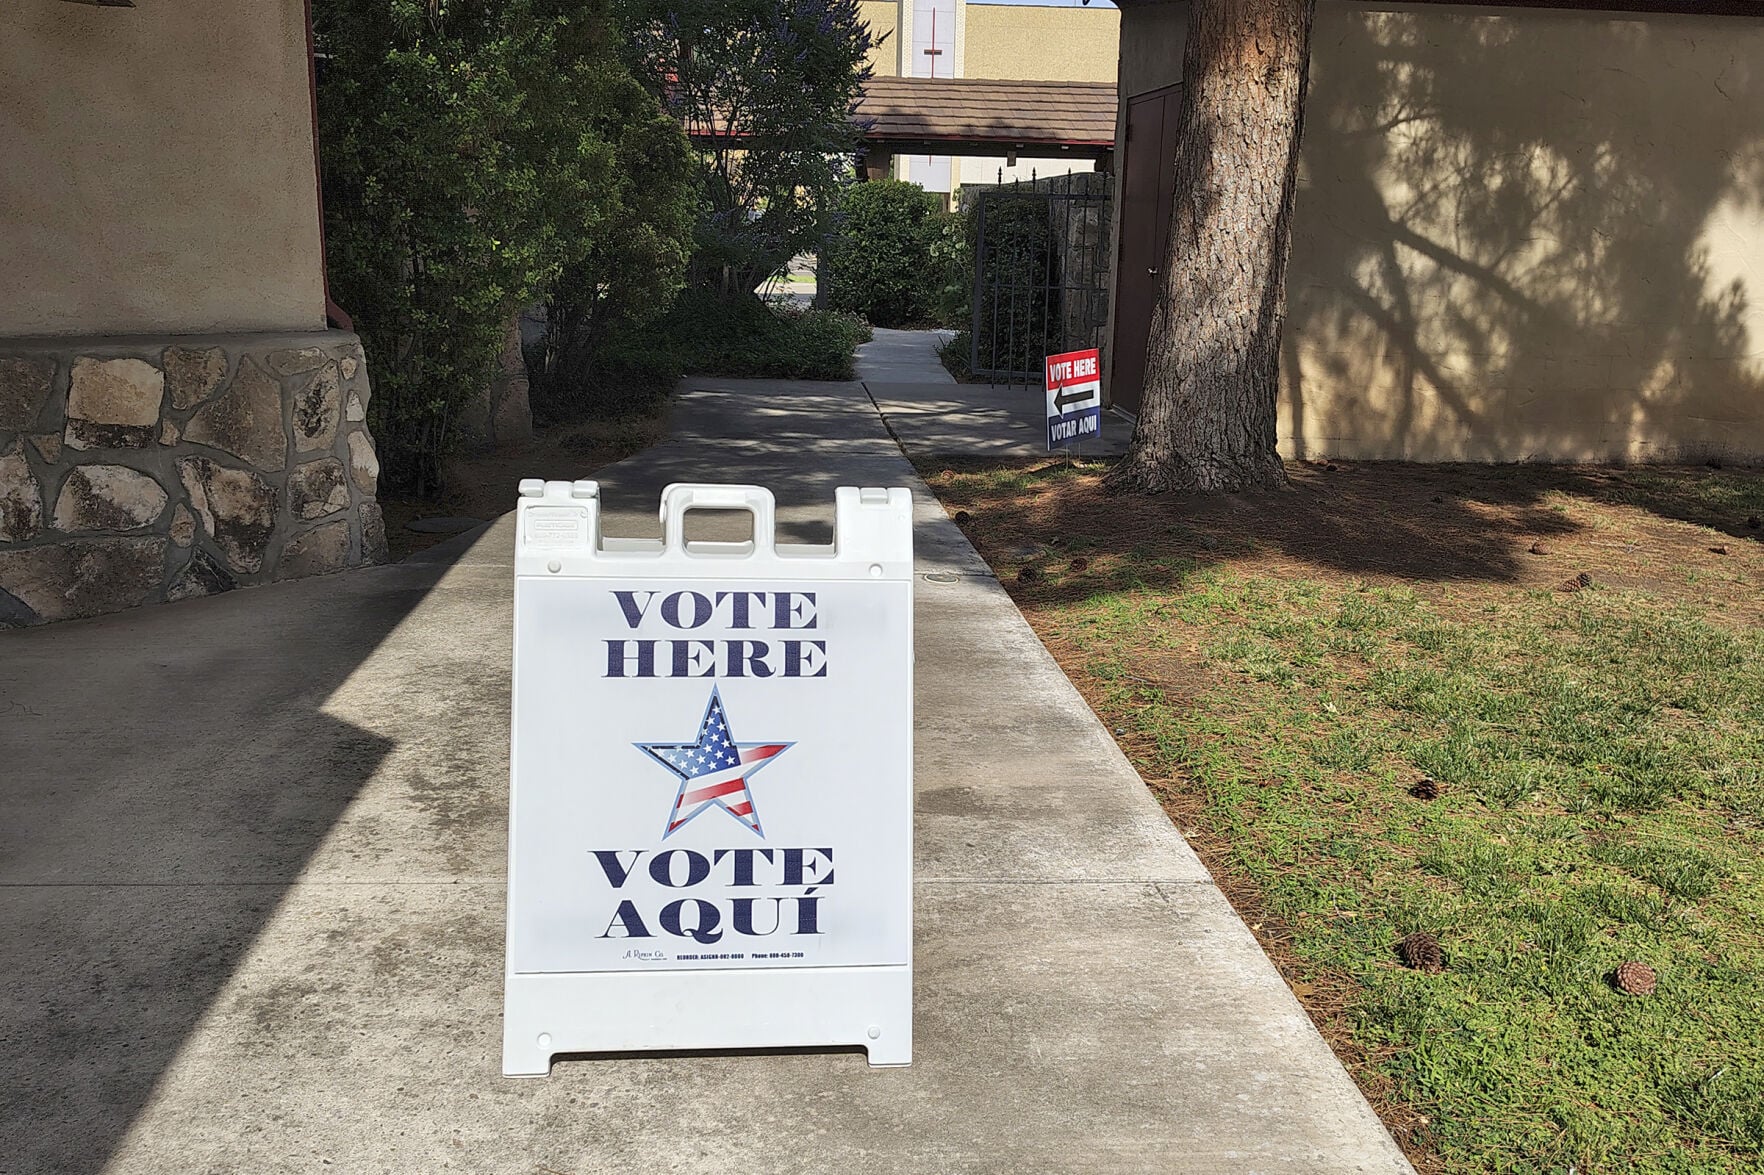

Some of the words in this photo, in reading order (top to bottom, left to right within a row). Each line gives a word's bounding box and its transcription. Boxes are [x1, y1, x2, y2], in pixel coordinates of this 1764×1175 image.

[1049, 361, 1073, 383] VOTE
[1073, 357, 1097, 378] HERE
[1051, 420, 1077, 442] VOTAR
[1078, 414, 1097, 434] AQUI
[610, 591, 817, 629] VOTE
[602, 640, 827, 677] HERE
[589, 848, 834, 889] VOTE
[595, 886, 824, 944] AQUÍ
